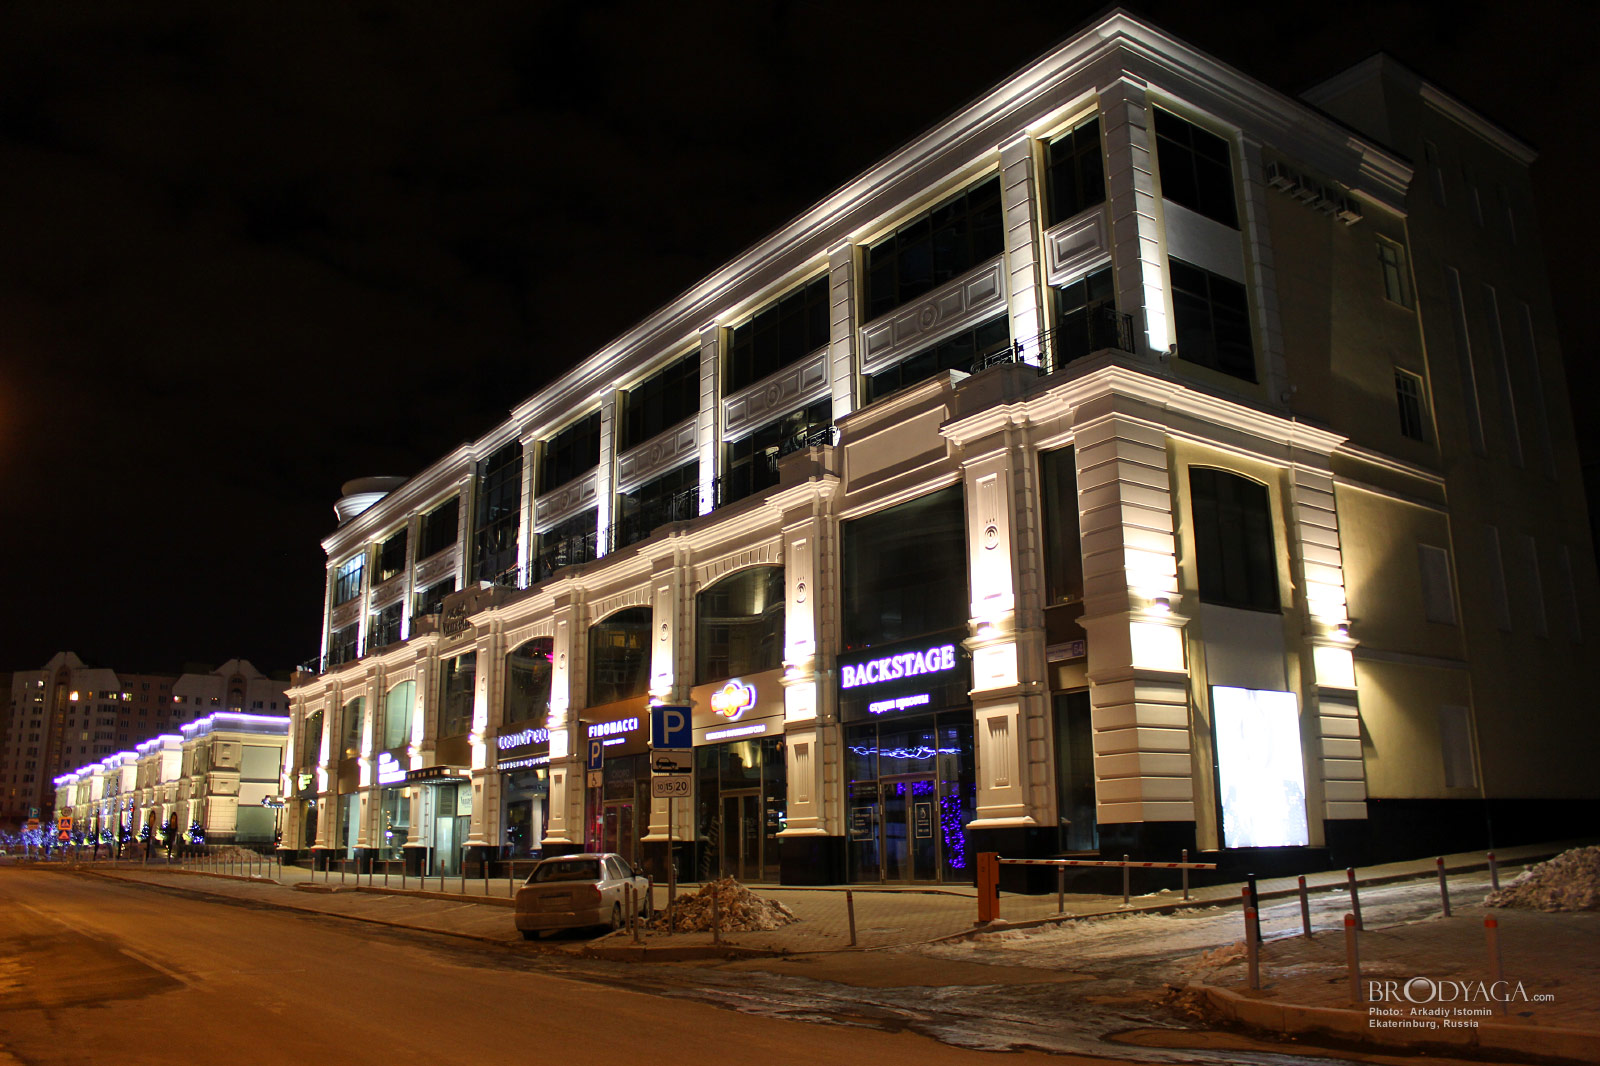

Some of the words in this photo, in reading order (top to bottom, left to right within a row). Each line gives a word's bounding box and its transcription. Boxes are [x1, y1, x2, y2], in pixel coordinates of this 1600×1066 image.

[842, 644, 956, 688] BACKSTAGE
[588, 718, 638, 737] FIBONACCI
[663, 710, 685, 744] P
[591, 741, 601, 767] P
[665, 783, 673, 791] 15
[675, 781, 687, 791] 20
